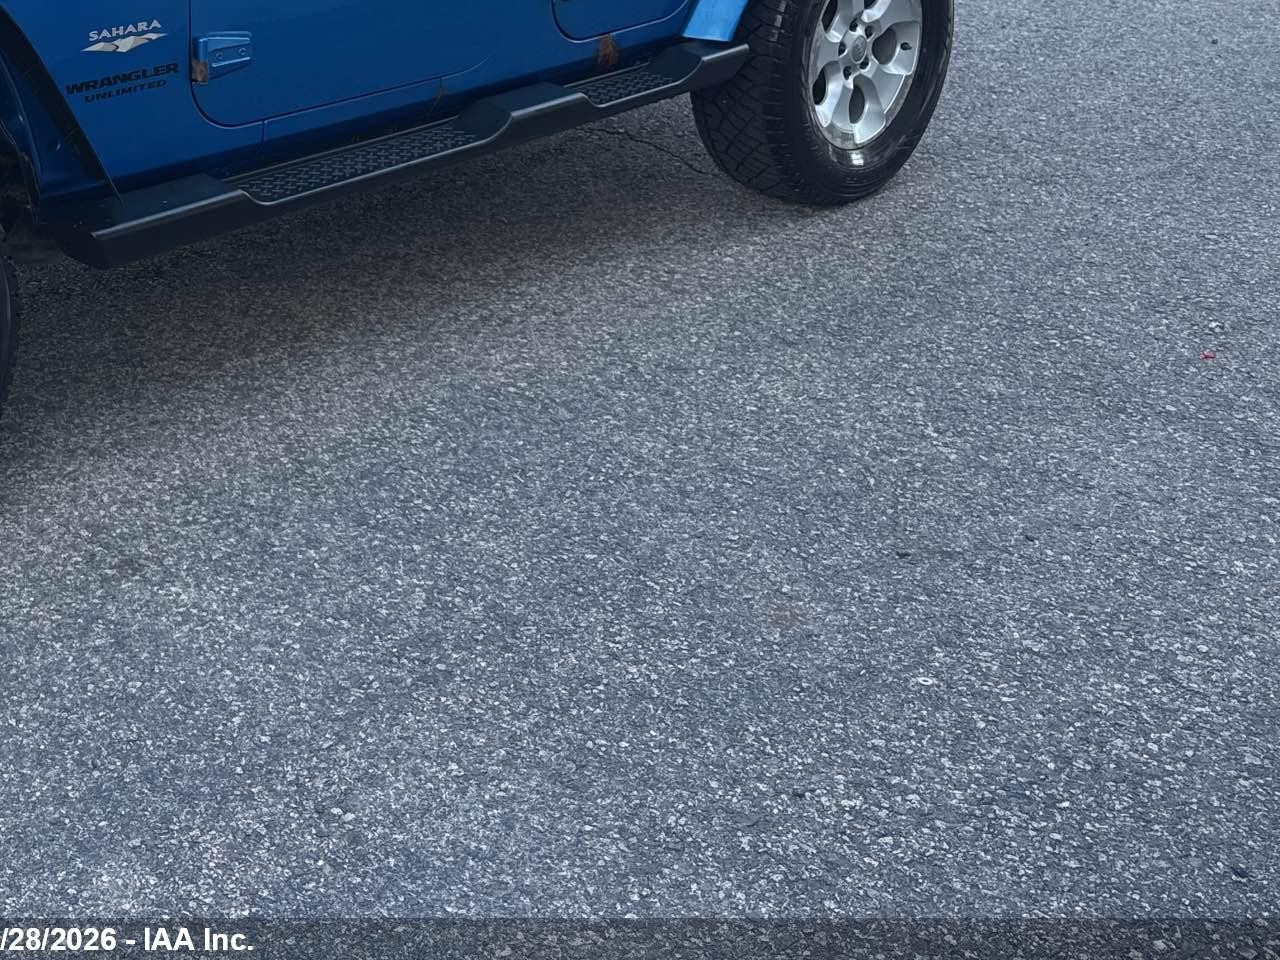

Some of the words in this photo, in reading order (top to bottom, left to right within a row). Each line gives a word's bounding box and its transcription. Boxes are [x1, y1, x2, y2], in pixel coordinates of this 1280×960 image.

[88, 19, 162, 42] SAHARA
[65, 62, 180, 95] WRANGLER
[84, 79, 167, 103] UNLIMITED
